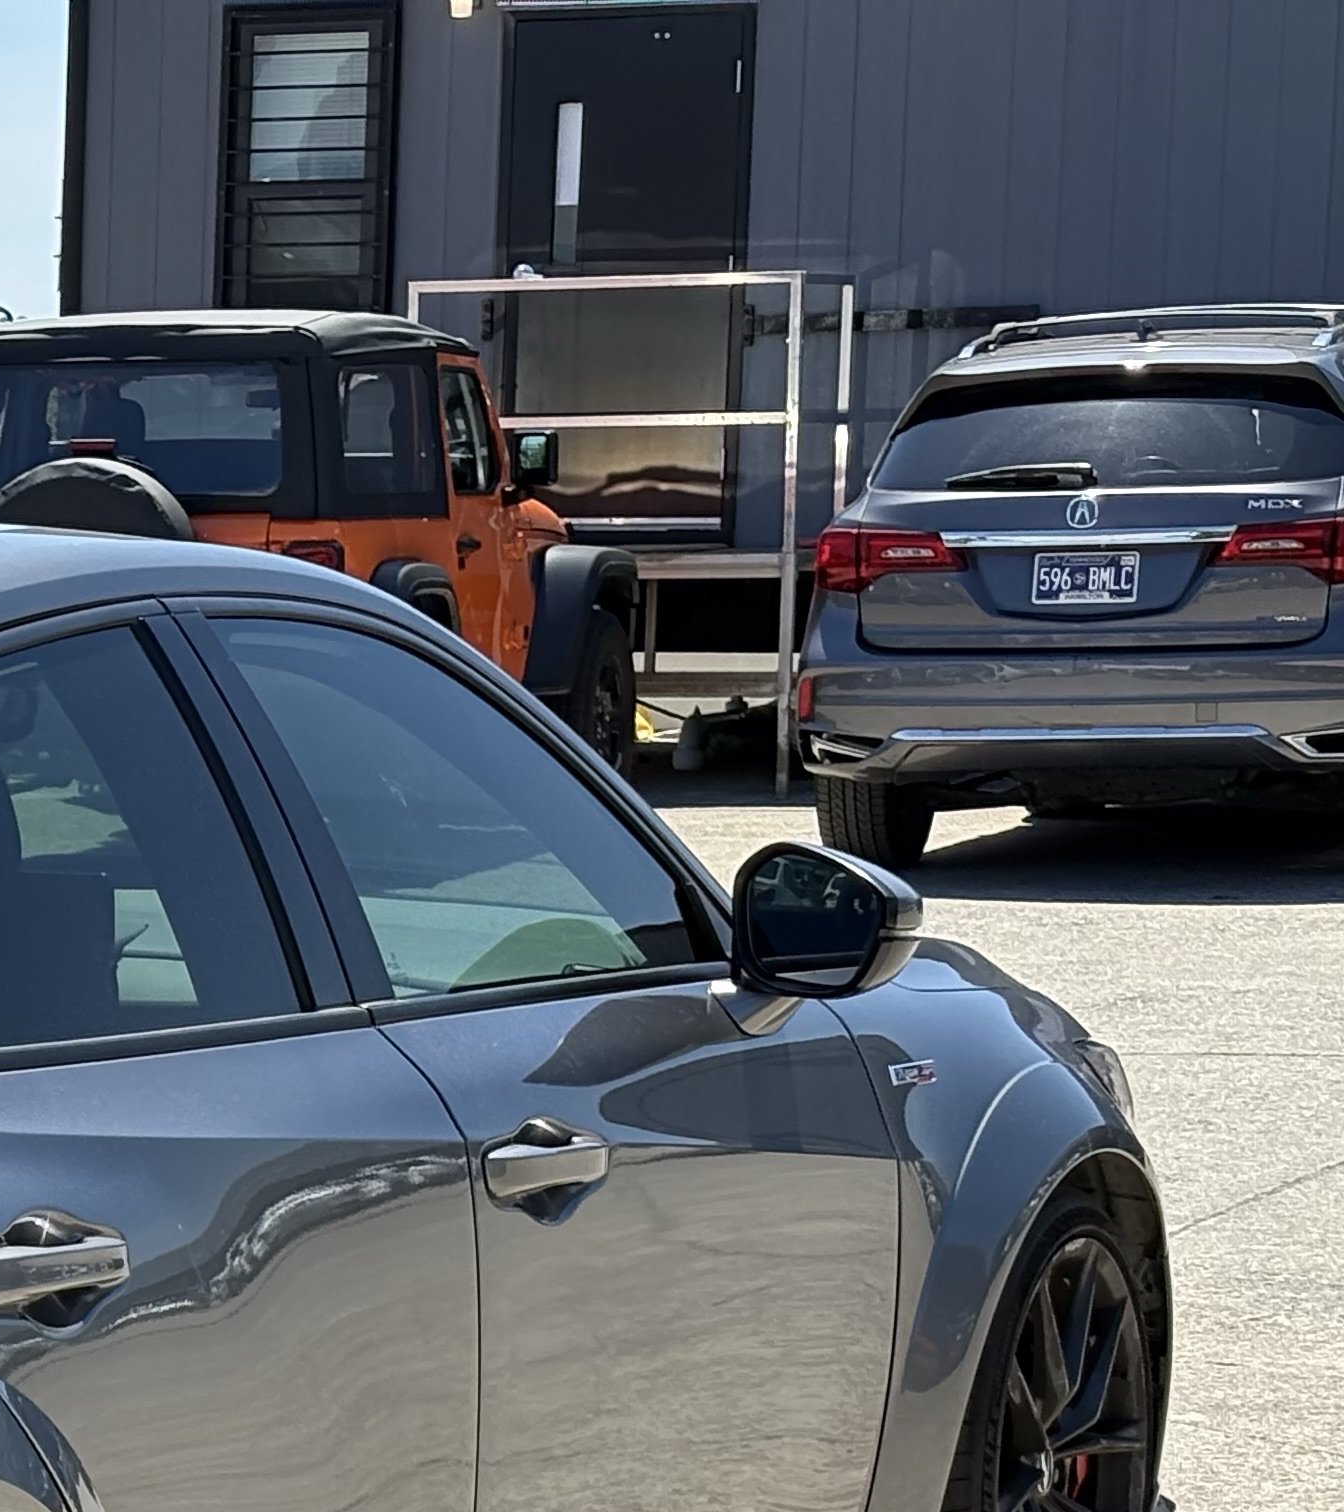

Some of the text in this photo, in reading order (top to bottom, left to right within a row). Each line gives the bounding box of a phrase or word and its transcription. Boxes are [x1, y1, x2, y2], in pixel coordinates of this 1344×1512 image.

[1247, 498, 1304, 510] MDX
[1038, 566, 1133, 591] 596 BMLC
